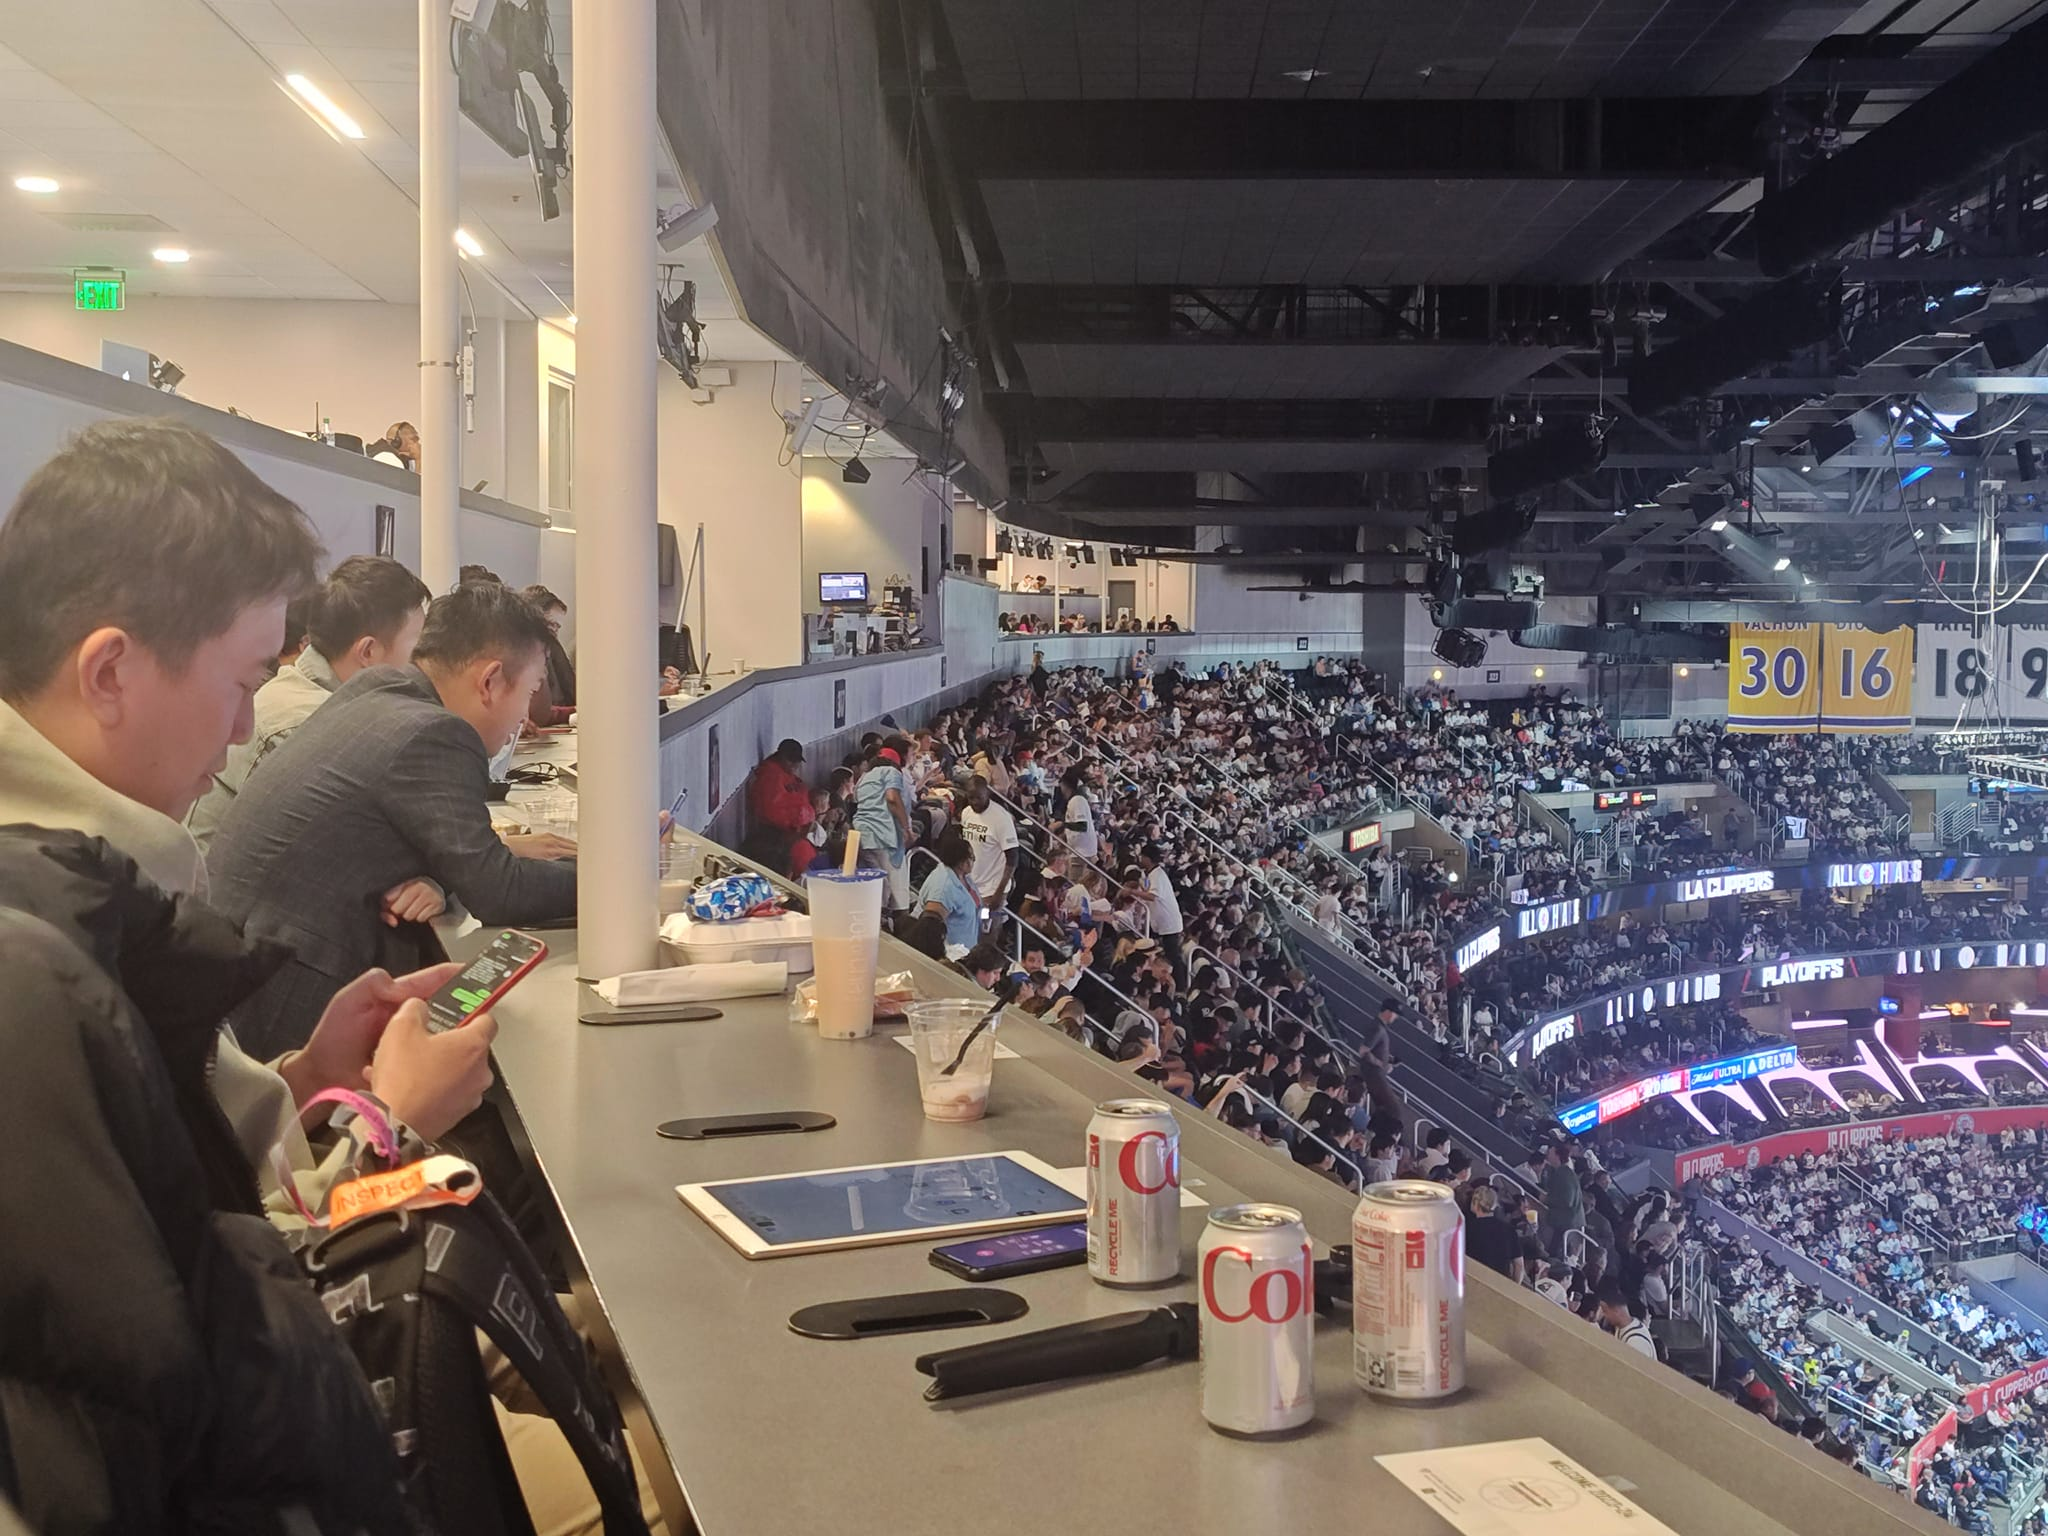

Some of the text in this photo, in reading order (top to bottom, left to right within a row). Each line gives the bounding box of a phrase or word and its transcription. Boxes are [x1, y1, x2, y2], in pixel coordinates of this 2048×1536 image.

[84, 281, 119, 309] EXIT
[1741, 648, 1805, 698] 30
[1841, 648, 1893, 698] 16
[1935, 648, 1987, 698] 18
[1684, 878, 1704, 902] LA
[1706, 870, 1775, 898] CLIPPERS
[1761, 957, 1844, 988] PLAYOFFS
[1758, 1051, 1793, 1070] DELTA
[1108, 1199, 1118, 1276] RECYCLE ME
[1439, 1300, 1450, 1390] RECYCLE ME
[1995, 1366, 2048, 1404] CLIPPERS.CO
